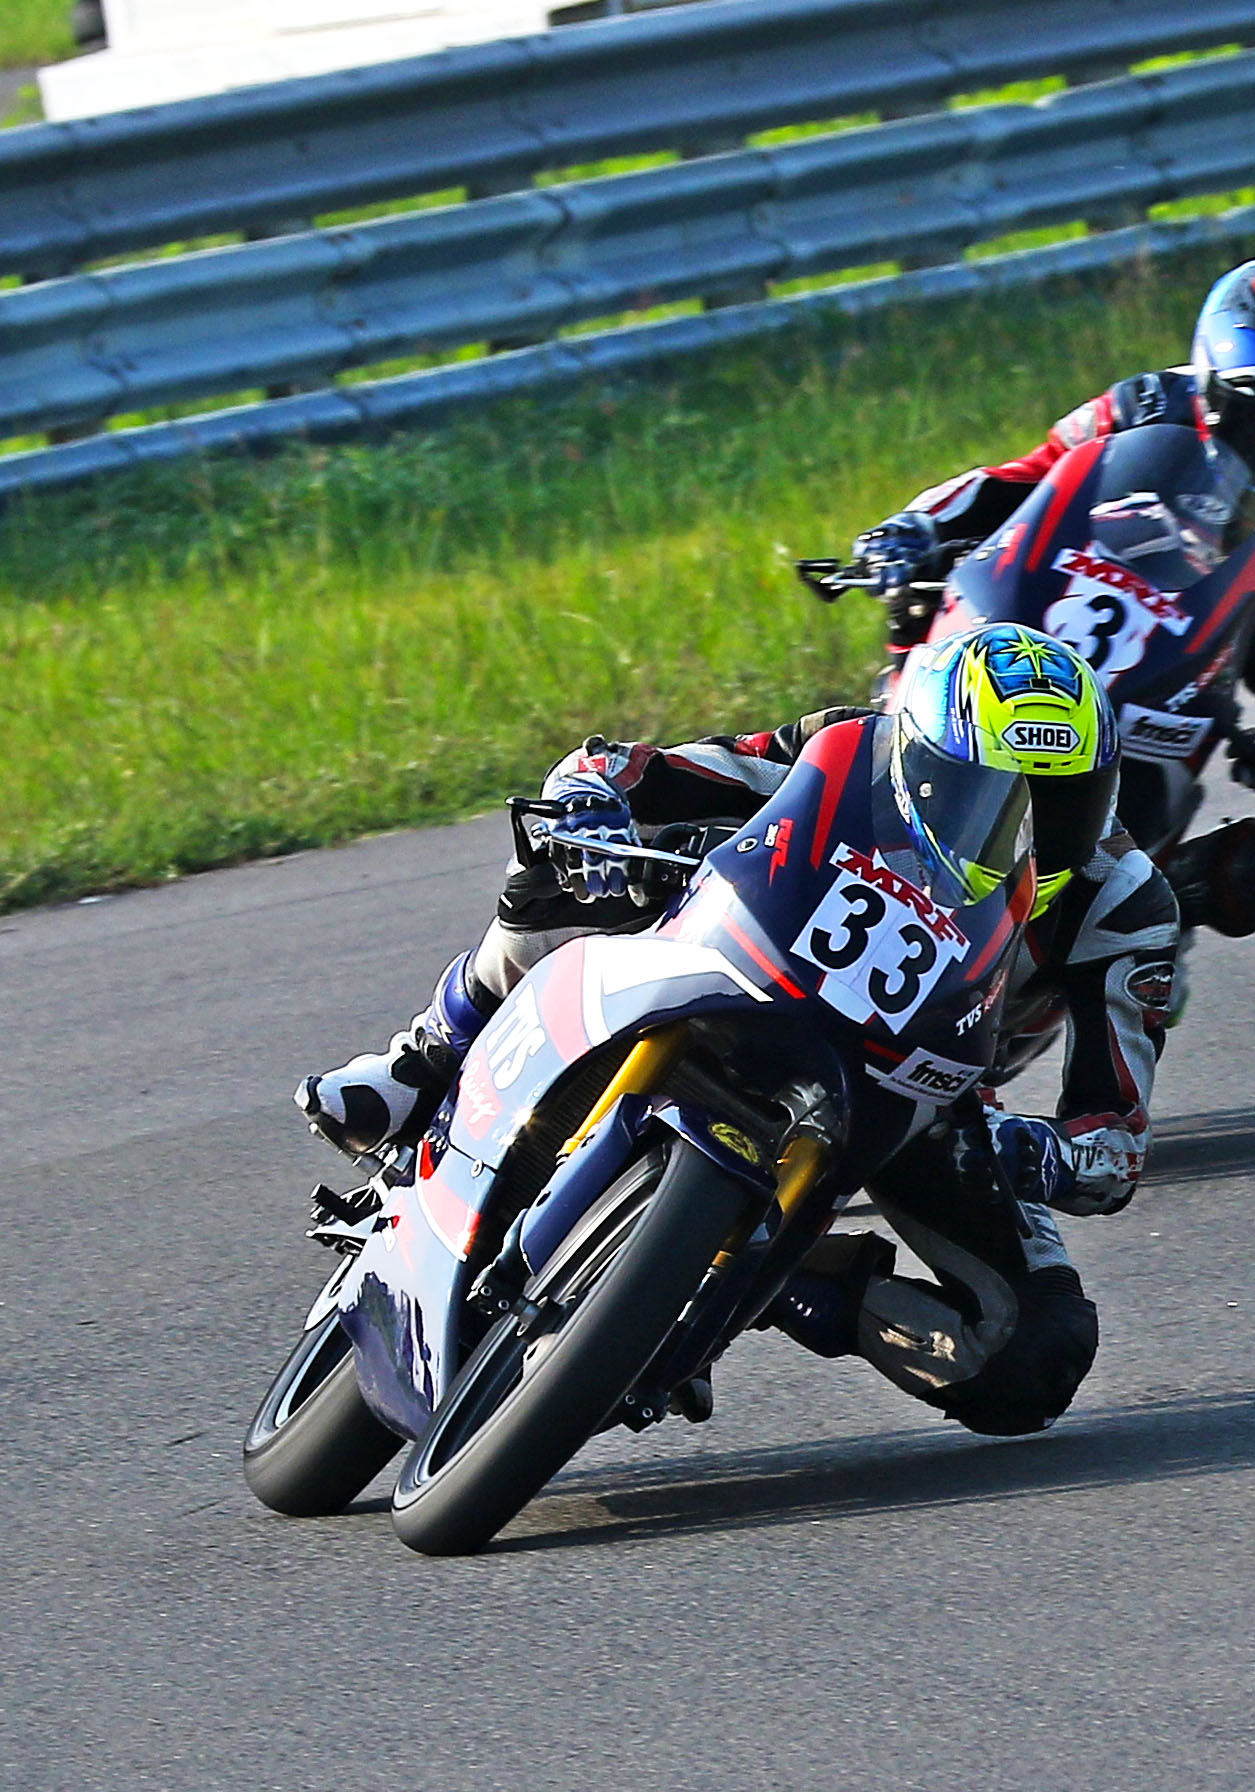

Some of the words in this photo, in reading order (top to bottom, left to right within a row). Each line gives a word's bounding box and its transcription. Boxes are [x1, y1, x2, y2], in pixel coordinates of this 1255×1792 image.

[1060, 552, 1185, 621] MRF
[1014, 725, 1072, 749] SHOEI
[835, 847, 966, 947] MRF
[809, 883, 938, 1016] 33
[485, 981, 547, 1091] TVS
[955, 1002, 982, 1037] TVS
